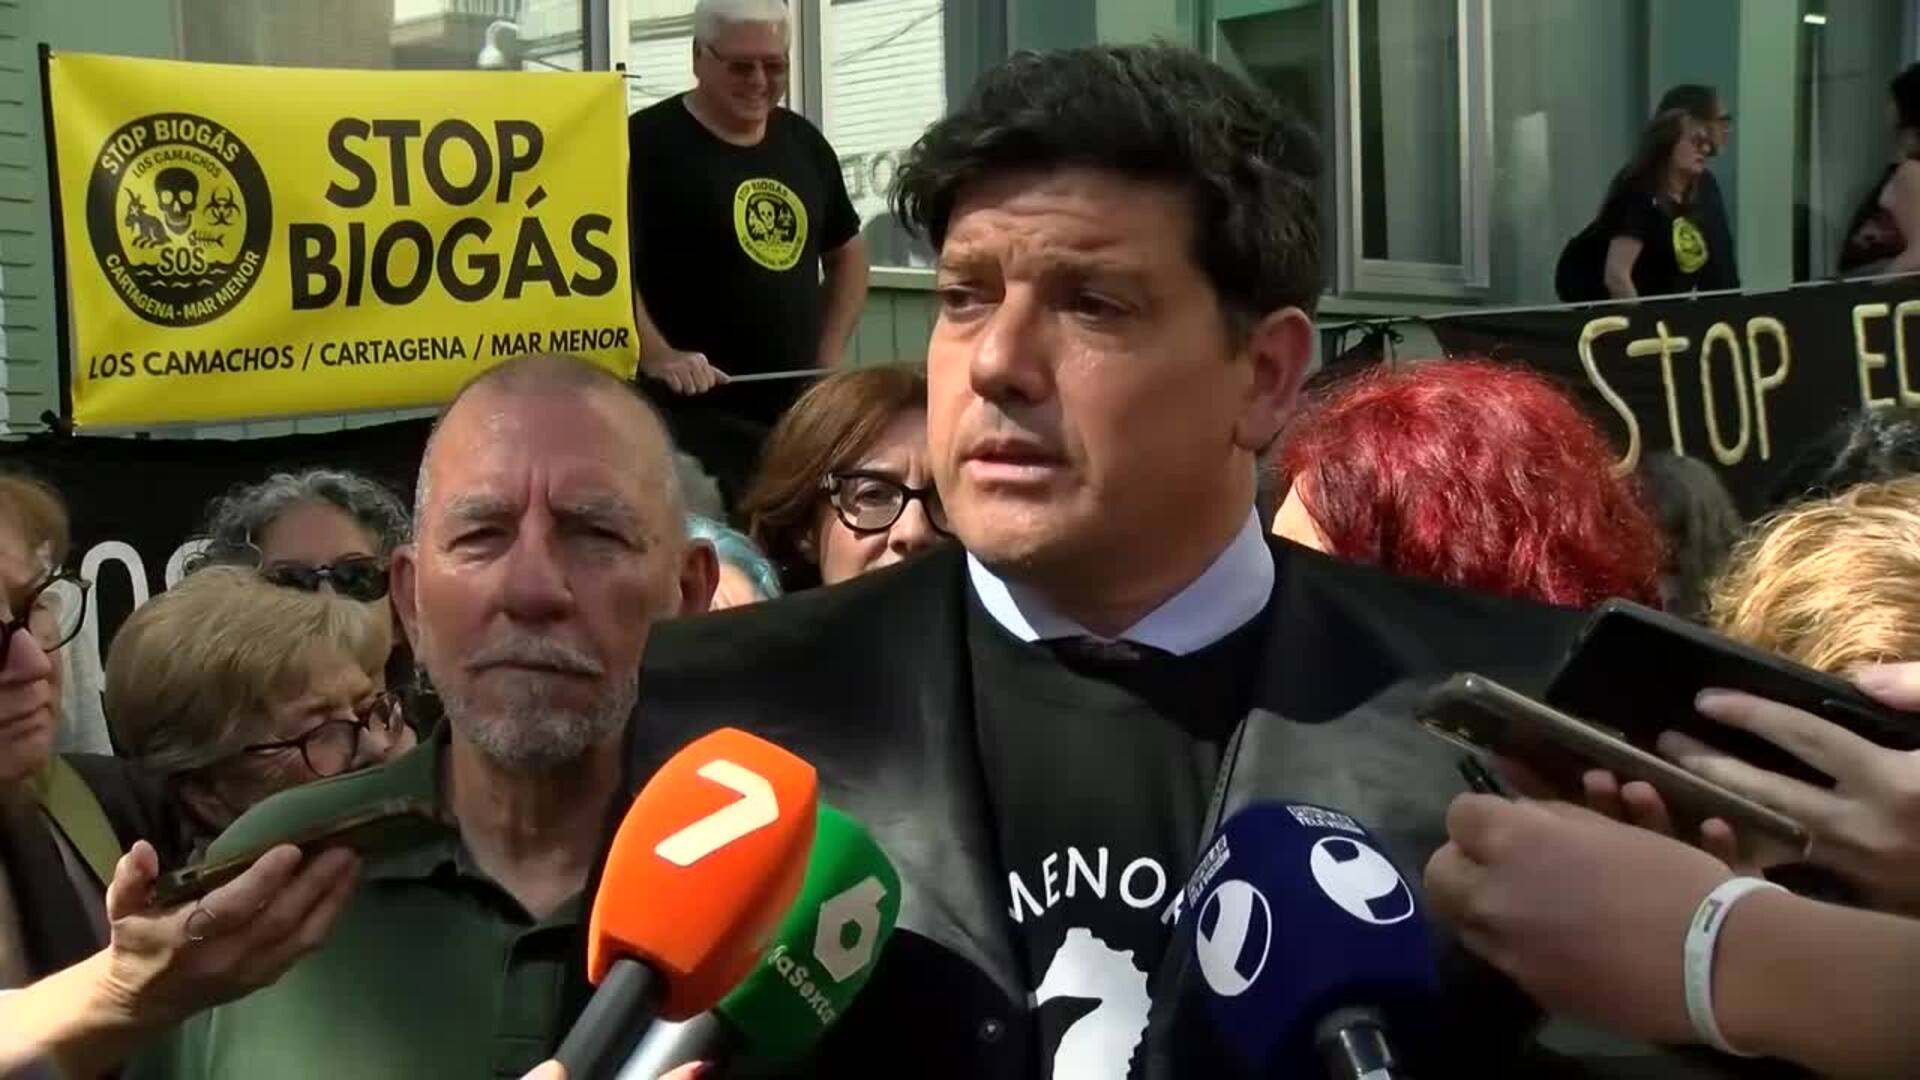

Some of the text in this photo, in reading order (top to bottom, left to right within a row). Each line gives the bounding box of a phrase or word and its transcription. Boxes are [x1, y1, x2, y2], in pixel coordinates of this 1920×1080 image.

[101, 119, 240, 174] STOP BIOGÁS
[131, 149, 222, 178] LOS CAMACHOS
[325, 117, 544, 208] STOP
[105, 253, 175, 320] CARTAGENA
[183, 297, 218, 320] MAR
[215, 250, 262, 306] MENOR
[159, 246, 207, 275] SOS
[289, 185, 618, 311] BIOGÁS
[88, 352, 136, 380] LOS
[142, 345, 295, 376] CAMACHOS
[320, 335, 466, 367] CARTAGENA
[491, 332, 544, 356] MAR
[550, 327, 629, 353] MENOR
[1578, 316, 1790, 479] STOP
[654, 759, 780, 868] 7
[813, 876, 888, 983] 6
